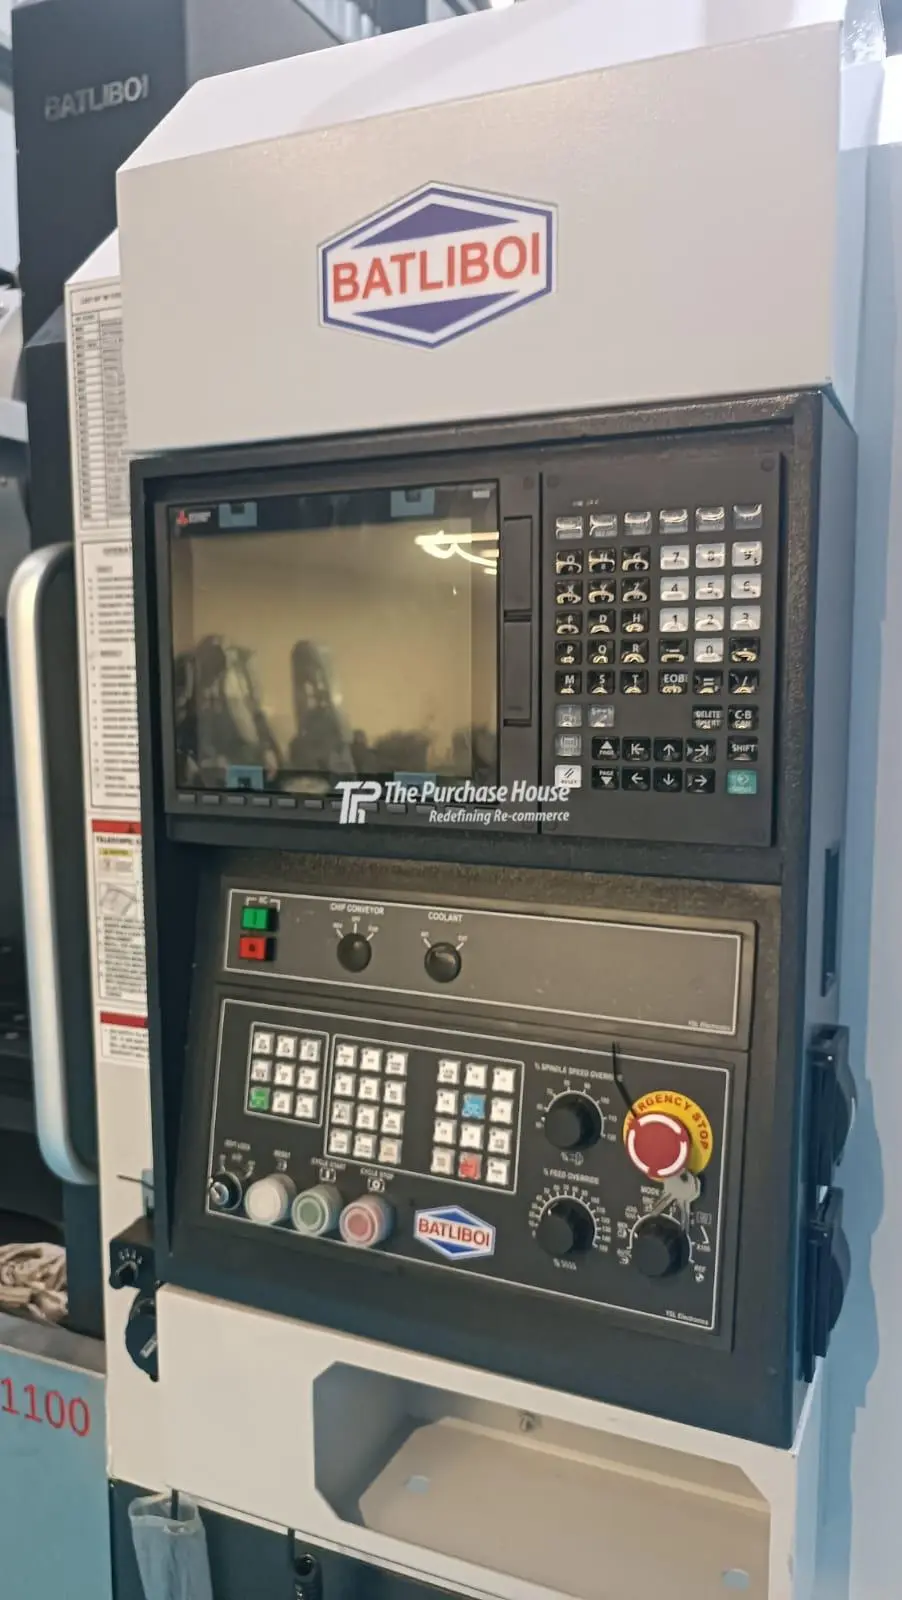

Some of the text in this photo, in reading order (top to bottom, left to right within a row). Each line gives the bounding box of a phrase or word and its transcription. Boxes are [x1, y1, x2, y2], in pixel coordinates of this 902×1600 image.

[44, 74, 149, 122] BATLIBOI
[332, 232, 541, 304] BATLIBOI
[673, 552, 680, 563] 7
[600, 614, 608, 624] D
[632, 613, 641, 623] H
[672, 614, 678, 625] 1
[566, 645, 574, 654] P
[632, 643, 640, 653] R
[564, 675, 575, 685] M
[599, 675, 606, 684] S
[731, 744, 756, 753] SHIFT
[346, 904, 385, 915] CONVEYOR
[428, 911, 463, 923] COOLANT
[568, 1066, 589, 1077] SPEED
[692, 1111, 710, 1150] STOP
[418, 1217, 490, 1247] BATLIBOI
[0, 1376, 91, 1437] 1100
